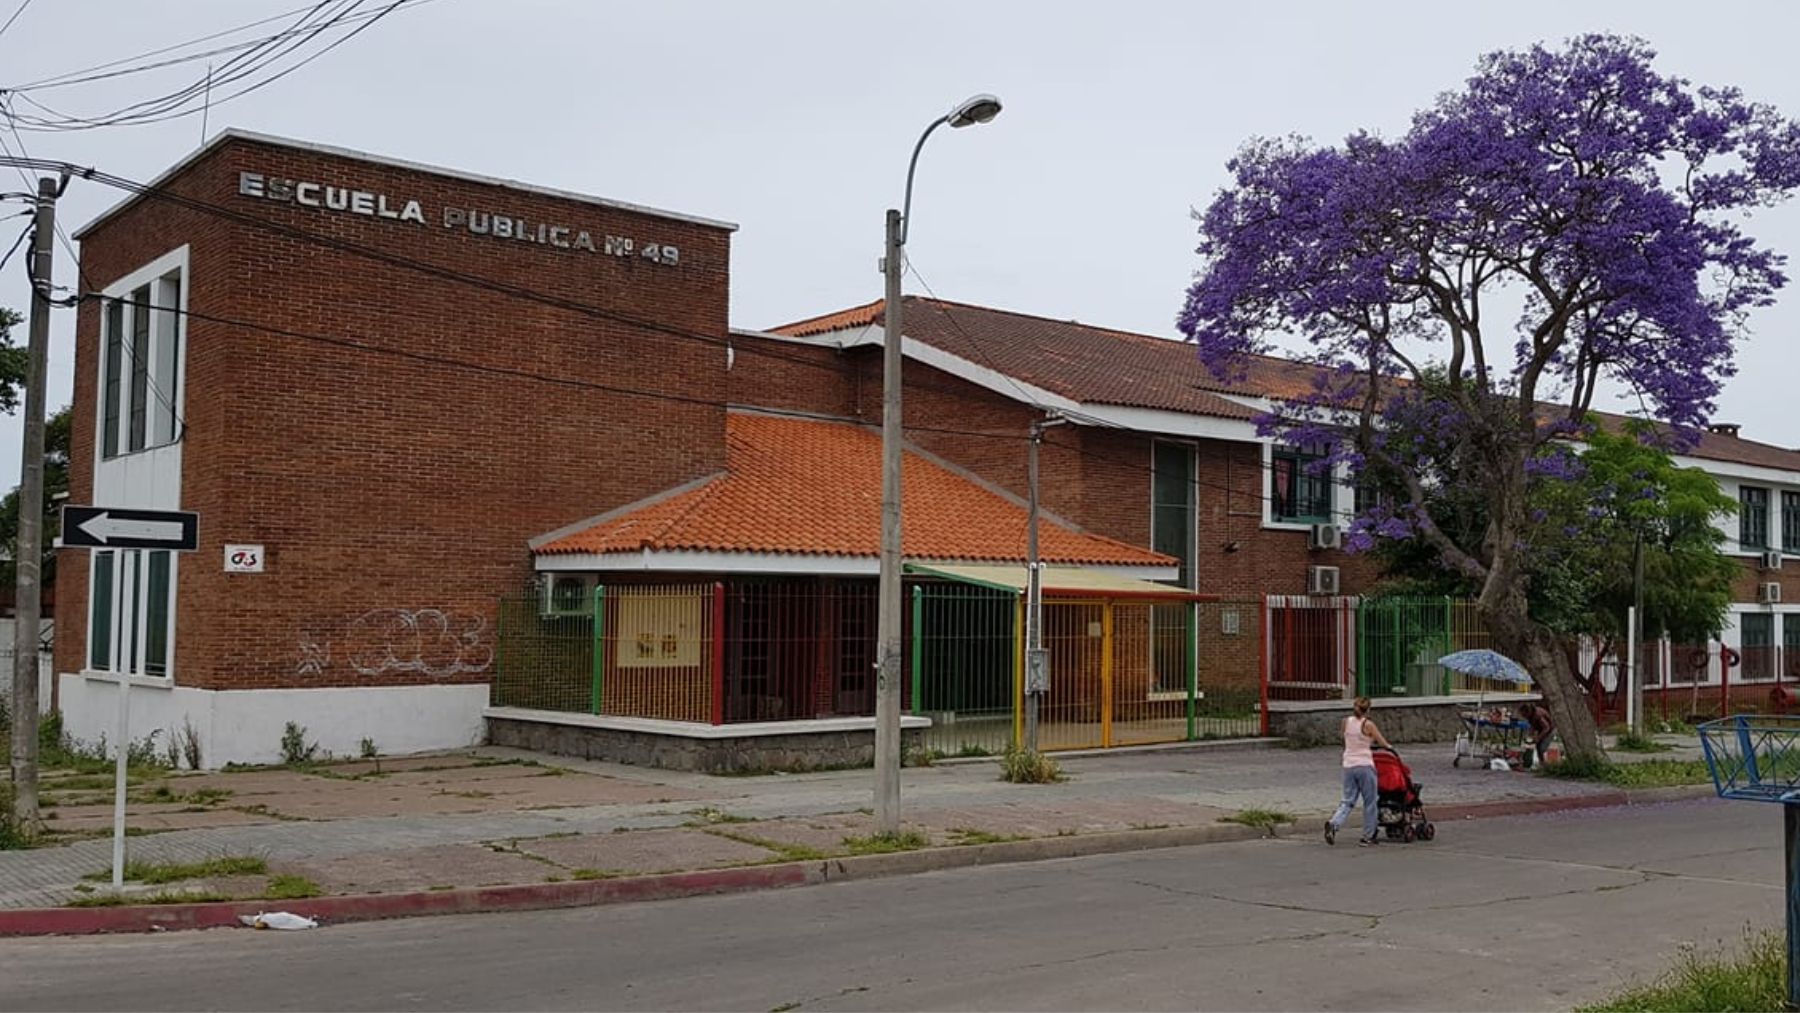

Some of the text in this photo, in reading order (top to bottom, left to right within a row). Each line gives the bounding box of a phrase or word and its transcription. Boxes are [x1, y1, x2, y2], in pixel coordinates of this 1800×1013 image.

[239, 171, 425, 224] ESCUELA
[444, 206, 596, 251] PUBLICA
[641, 243, 679, 266] 49
